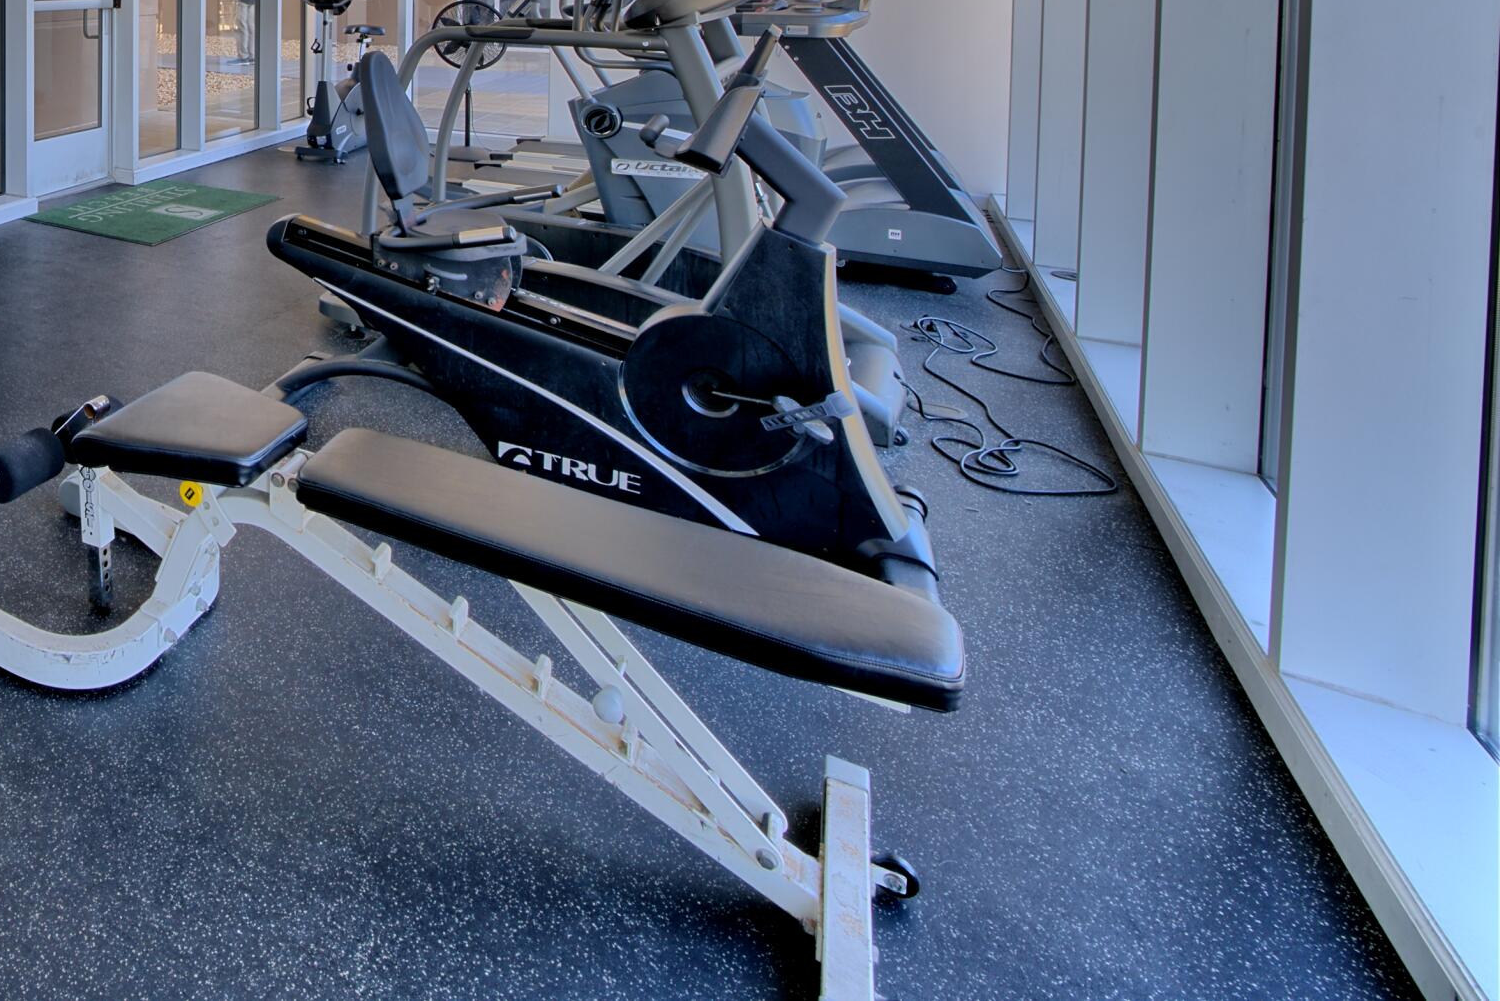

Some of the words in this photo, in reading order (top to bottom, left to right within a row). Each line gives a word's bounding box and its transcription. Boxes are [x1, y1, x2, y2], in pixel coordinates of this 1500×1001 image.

[823, 84, 896, 139] BH
[77, 186, 197, 224] STERLING
[534, 449, 642, 495] TRUE
